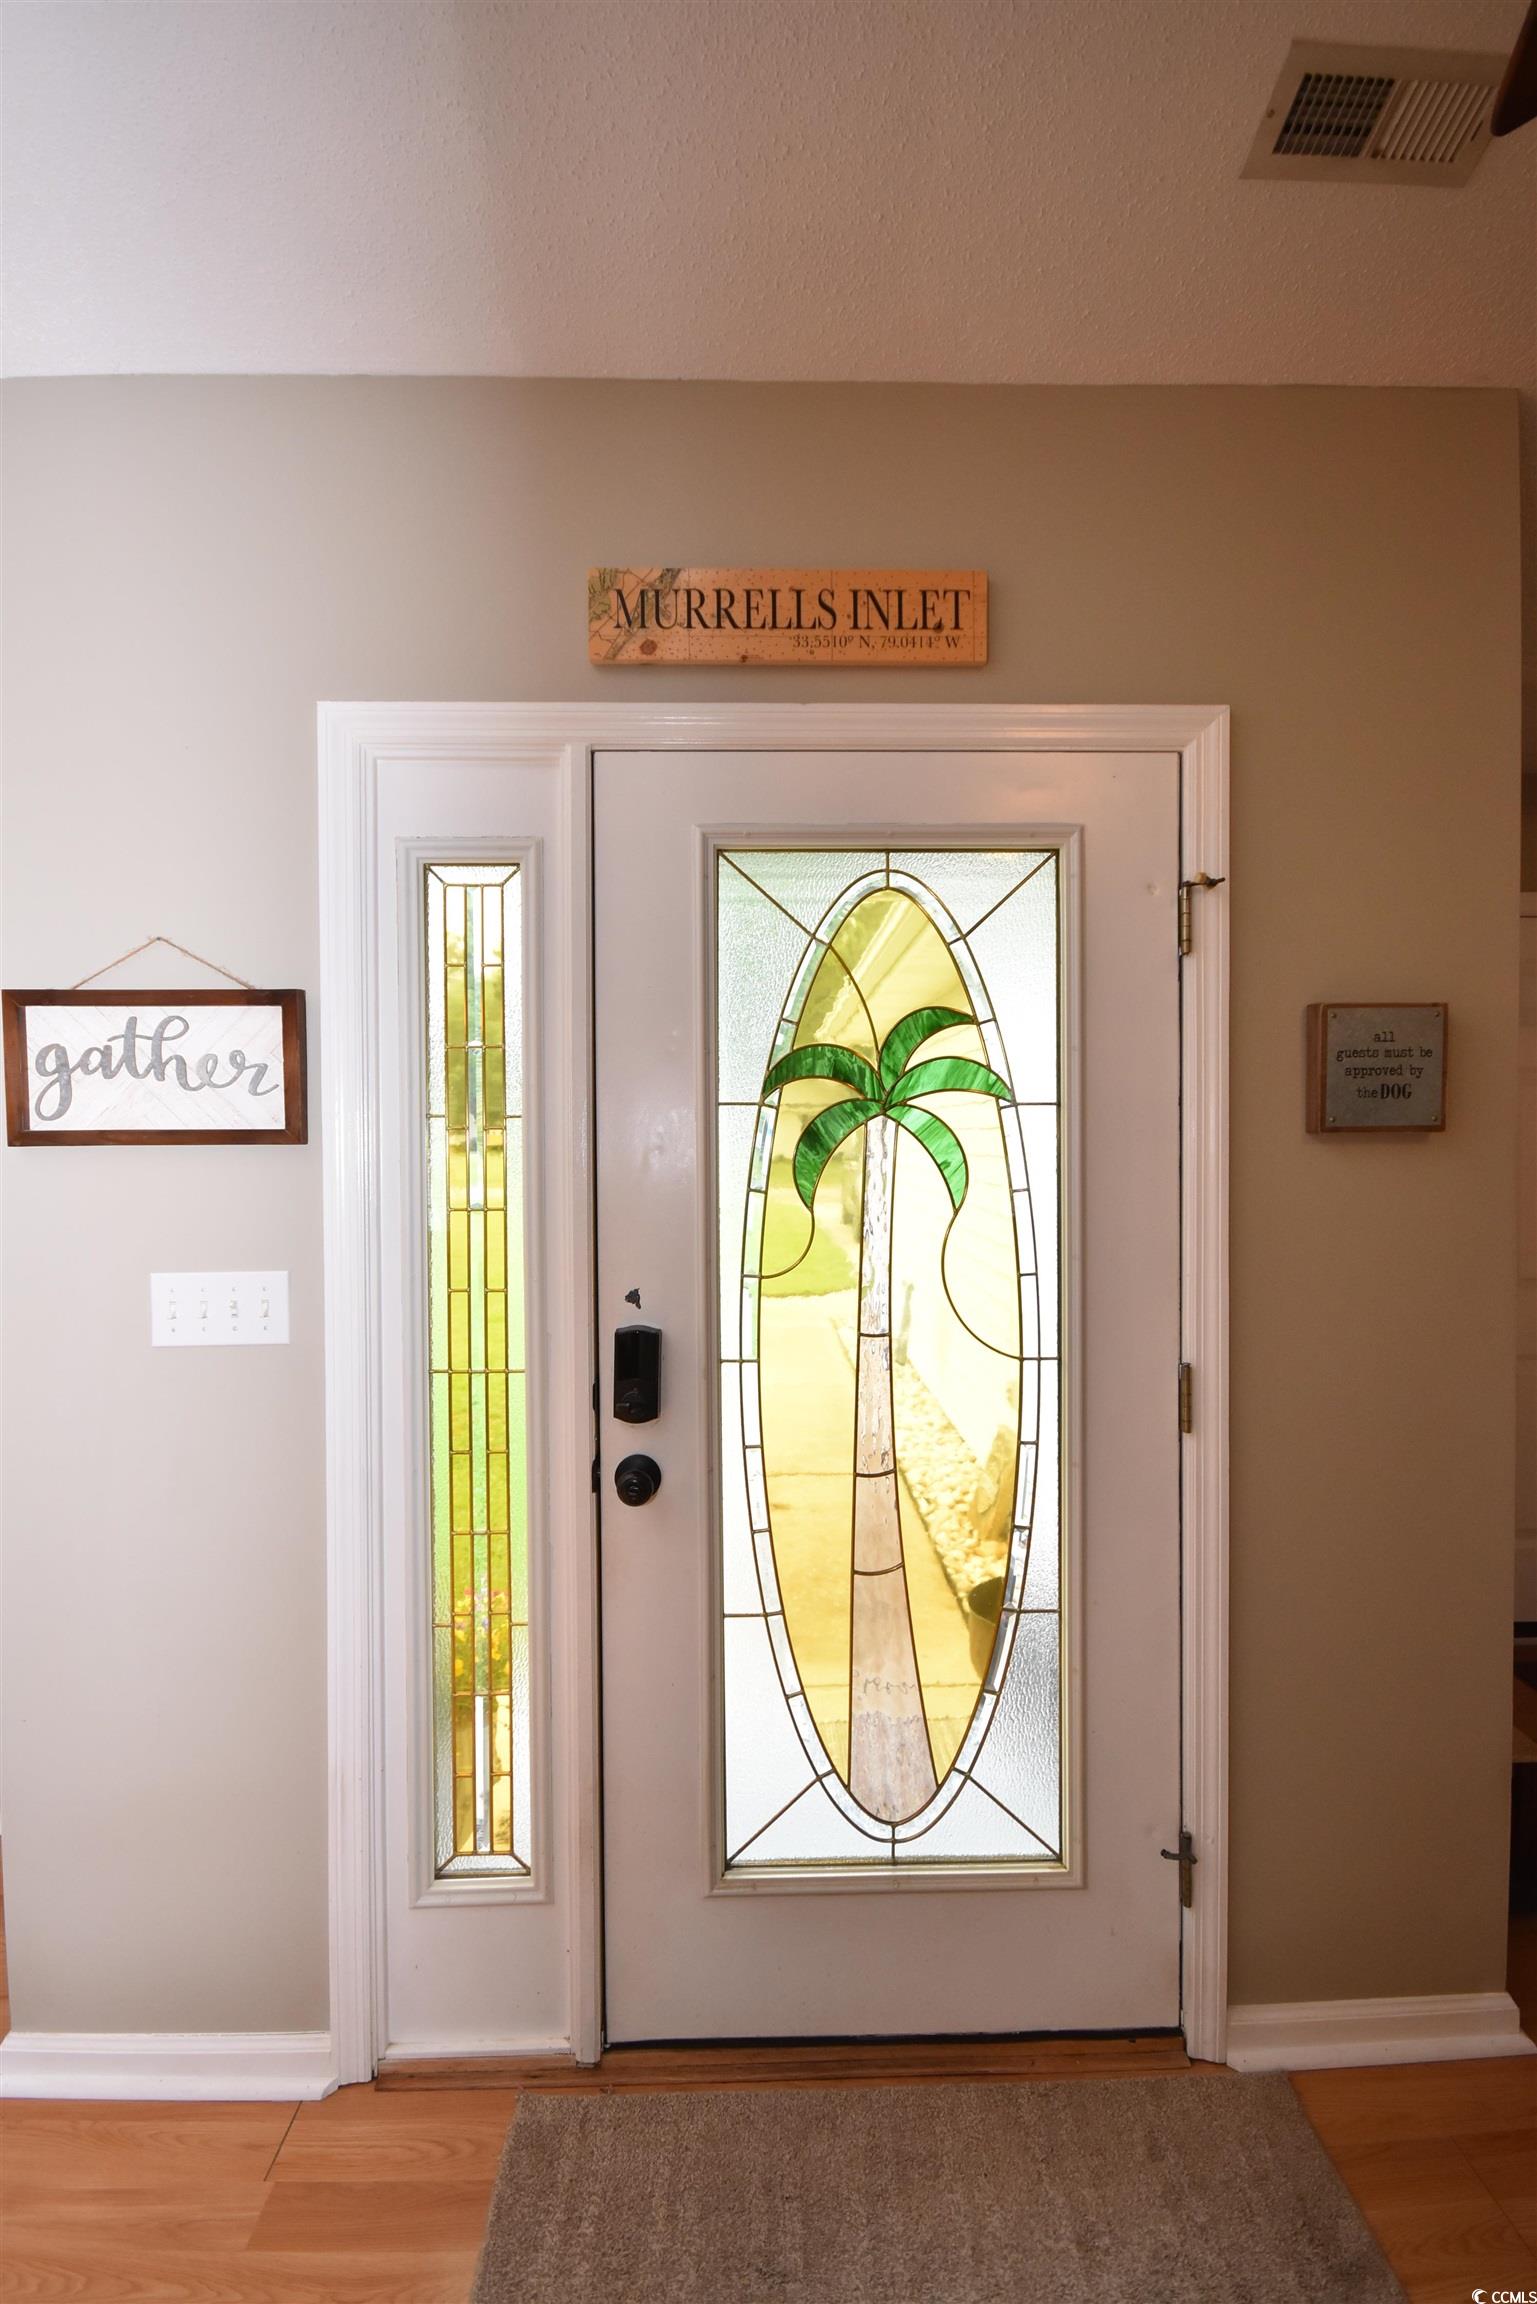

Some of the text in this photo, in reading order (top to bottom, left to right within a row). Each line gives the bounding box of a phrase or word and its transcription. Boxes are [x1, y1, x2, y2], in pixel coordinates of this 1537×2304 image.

[614, 588, 971, 630] MURRELLS INLET
[945, 635, 961, 649] W
[1374, 1031, 1395, 1043] all
[1336, 1046, 1433, 1062] guests must be
[34, 1015, 280, 1121] gather
[1344, 1064, 1424, 1079] approved by
[1356, 1083, 1412, 1100] the DOG
